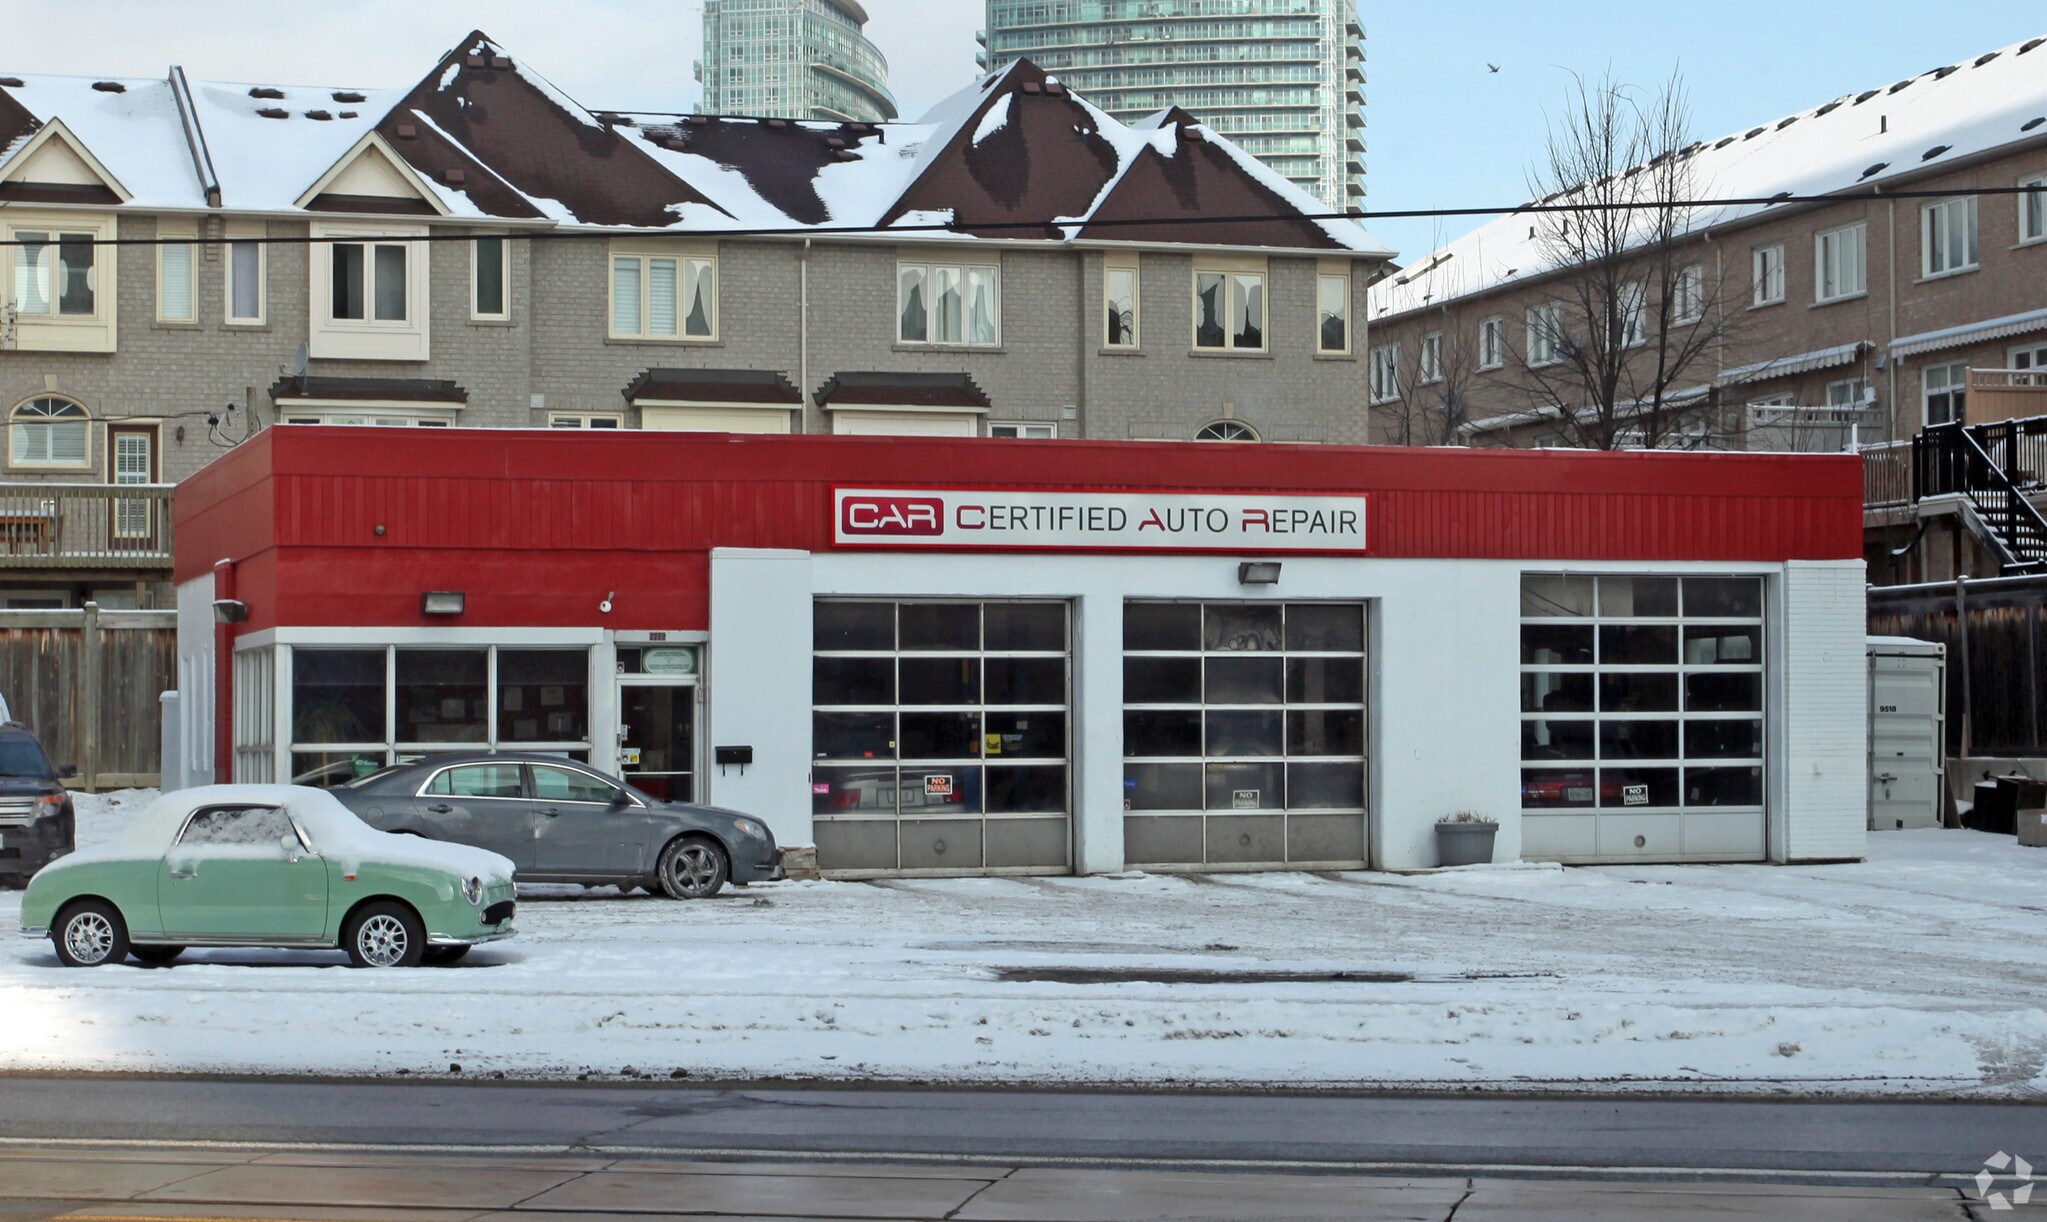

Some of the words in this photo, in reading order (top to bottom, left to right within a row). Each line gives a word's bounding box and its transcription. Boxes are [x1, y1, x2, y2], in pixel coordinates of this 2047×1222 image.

[849, 503, 936, 529] CAR
[956, 505, 1127, 531] CERTIFIED
[1138, 507, 1229, 533] AUTO
[1242, 509, 1358, 534] REPAIR
[1879, 705, 1897, 713] 9518
[927, 784, 950, 792] PARKING
[1625, 794, 1646, 802] PARKING
